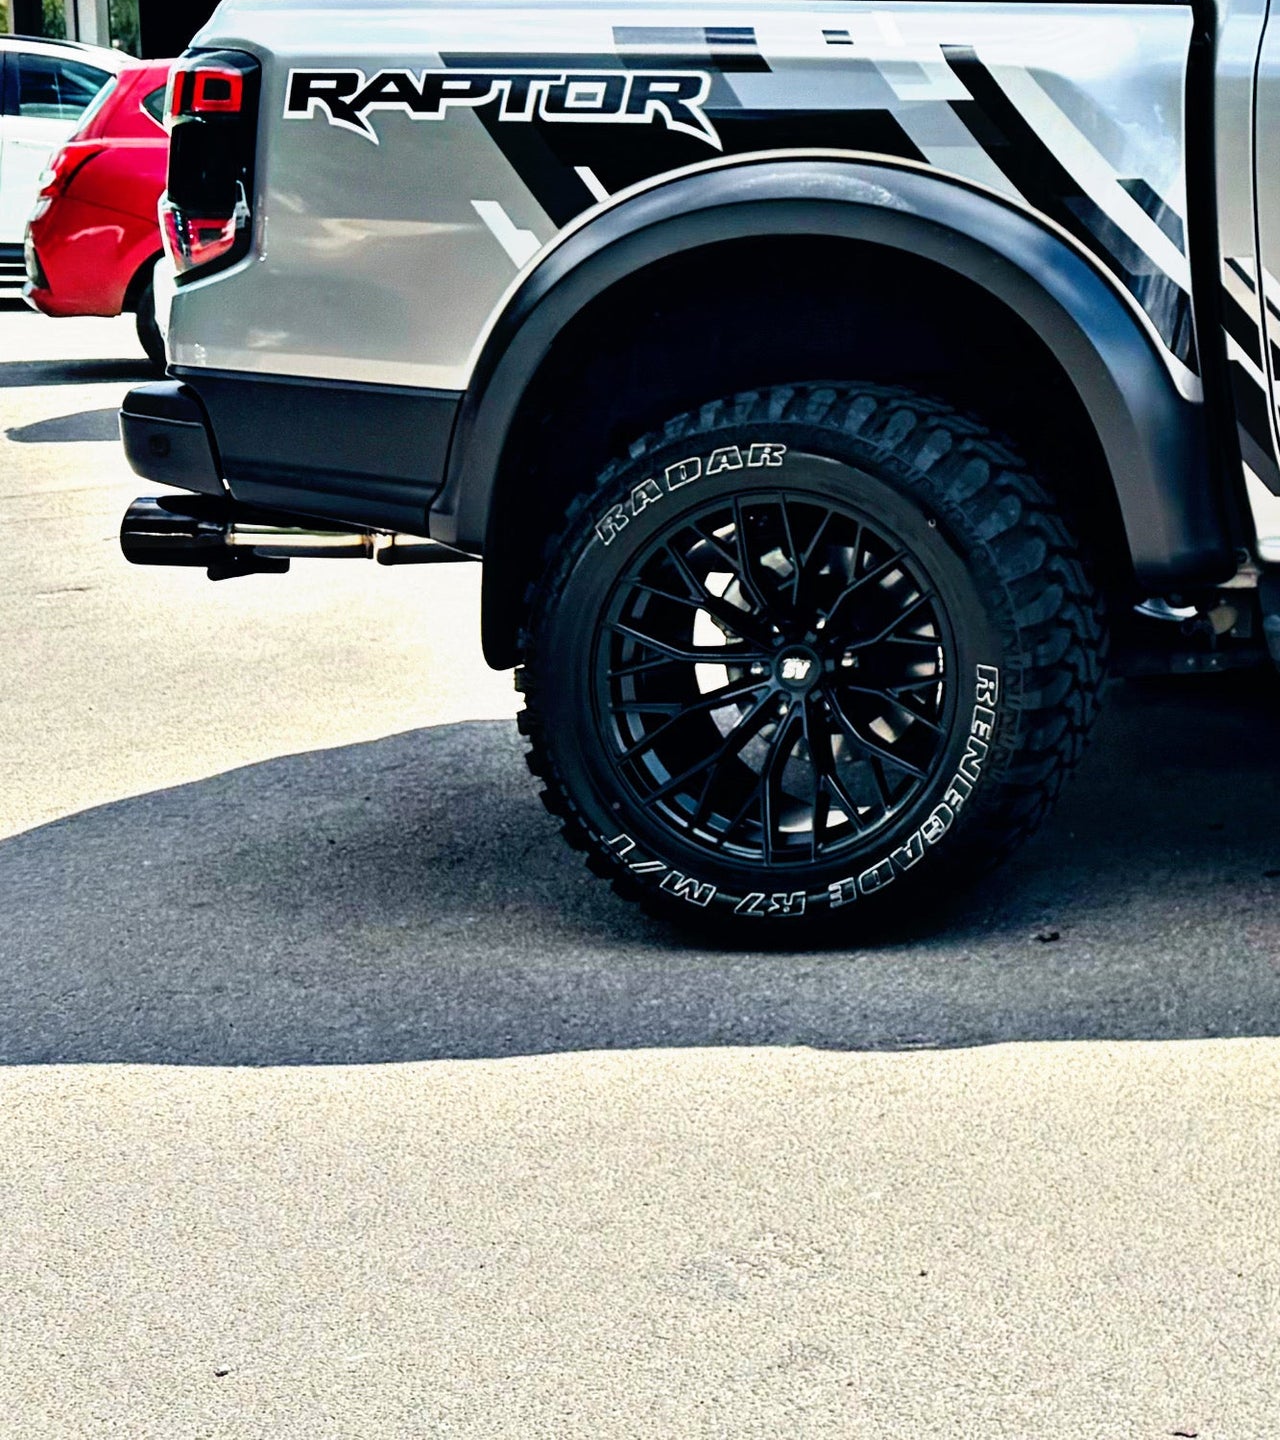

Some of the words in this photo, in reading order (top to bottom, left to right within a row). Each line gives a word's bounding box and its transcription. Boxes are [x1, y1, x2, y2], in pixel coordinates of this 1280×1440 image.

[283, 68, 722, 151] RAPTOR
[595, 443, 787, 546] RADAR
[828, 663, 1000, 907] RENEGADE
[600, 833, 717, 907] M/T
[734, 890, 809, 917] R7
